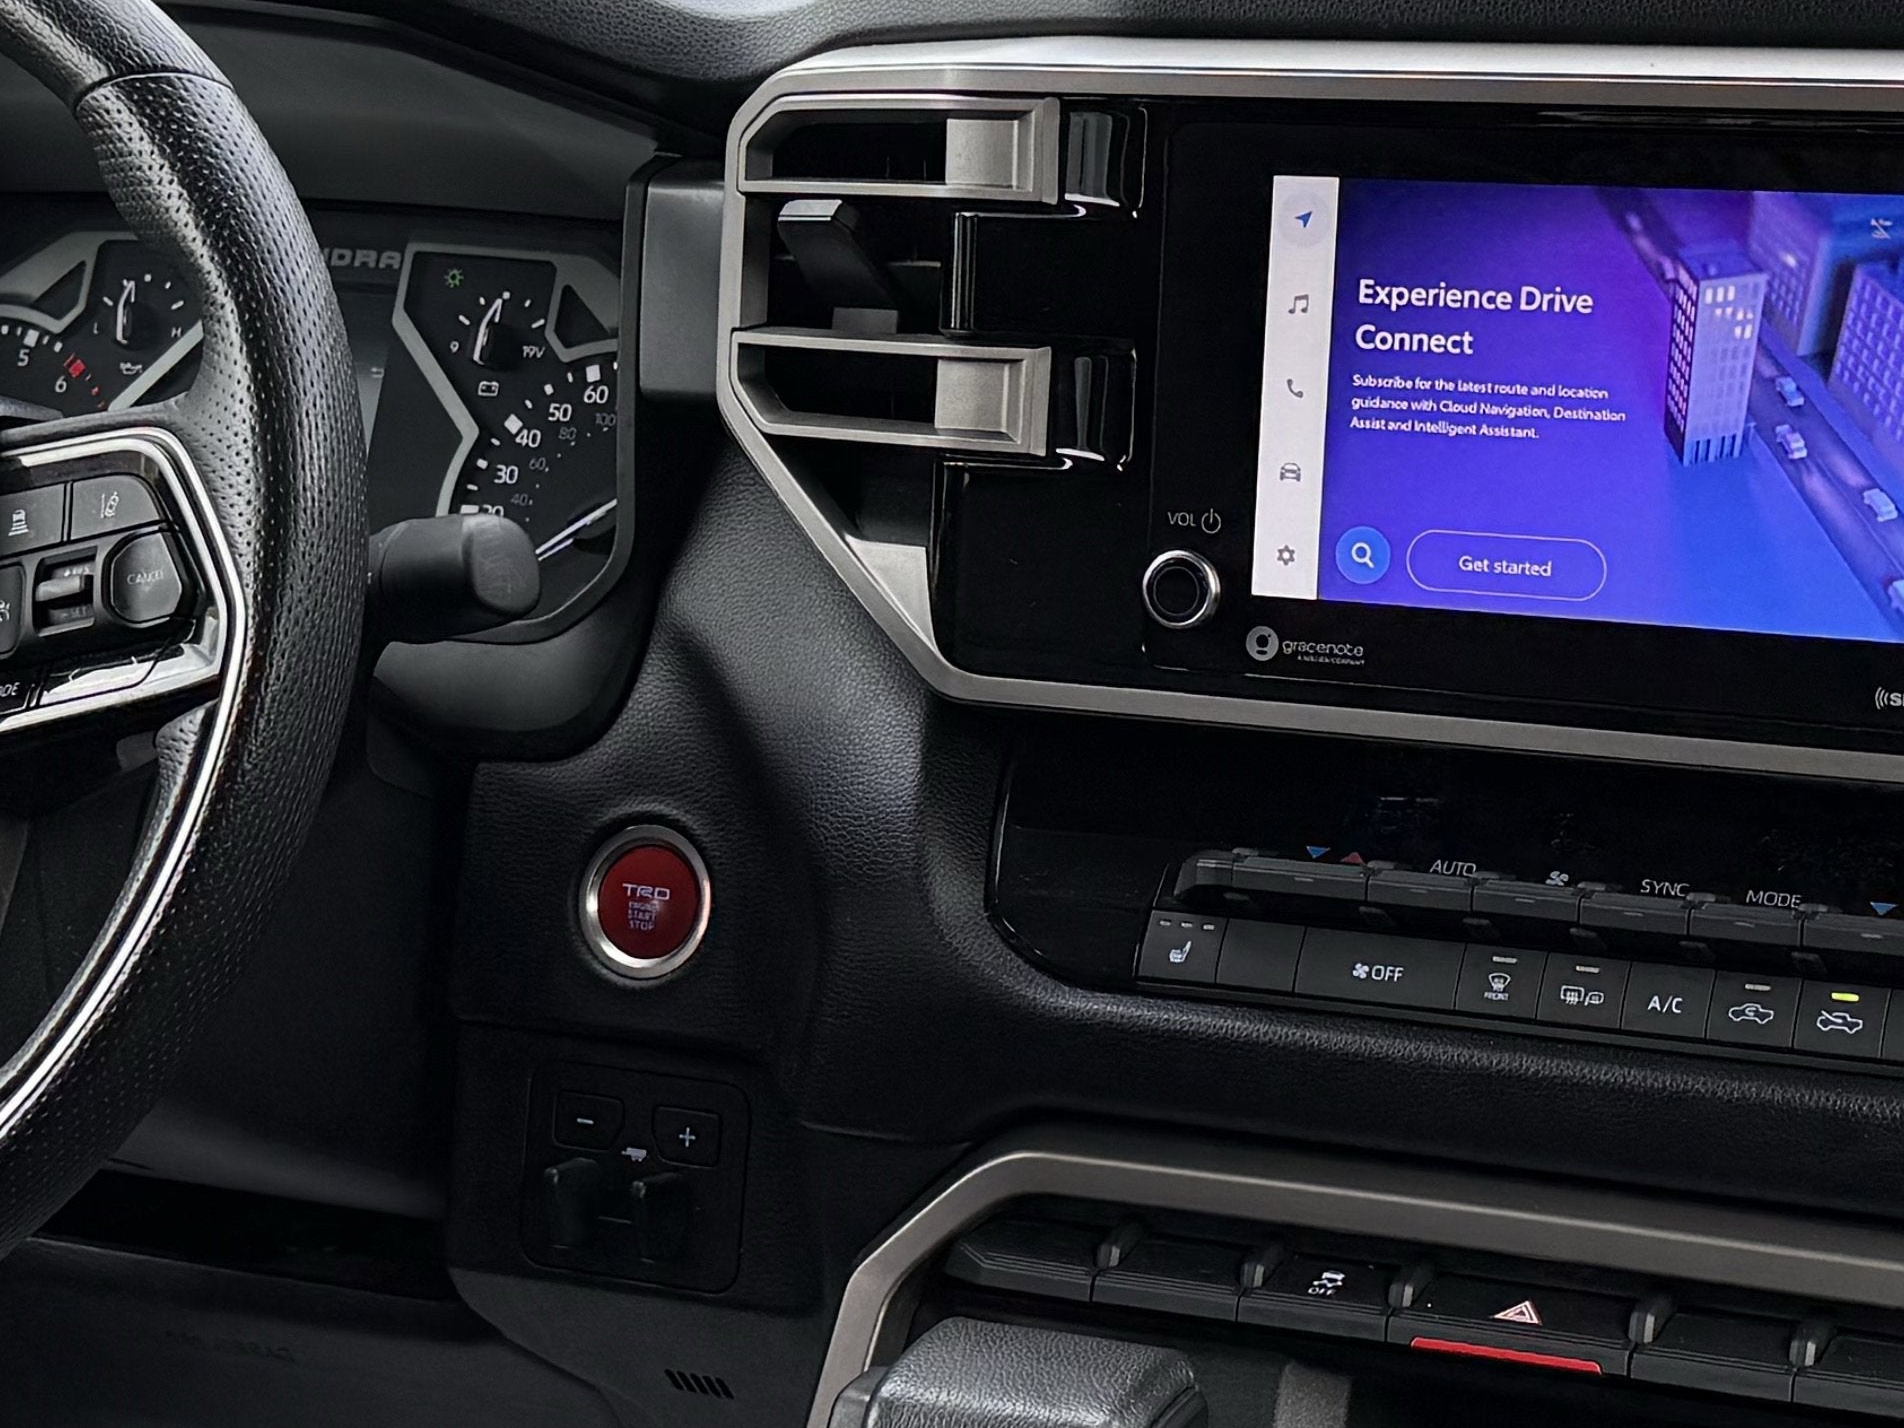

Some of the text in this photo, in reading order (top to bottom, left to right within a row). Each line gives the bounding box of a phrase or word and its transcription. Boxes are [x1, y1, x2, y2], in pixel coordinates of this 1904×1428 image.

[324, 247, 402, 270] DRA
[1358, 278, 1594, 314] Experience Drive
[171, 326, 183, 338] H
[1355, 324, 1474, 355] Connect
[450, 341, 460, 354] 9
[17, 348, 30, 368] 5
[54, 375, 67, 394] 6
[1352, 374, 1609, 400] Subscribe for the latest route and location
[583, 385, 609, 404] 60
[548, 403, 573, 422] 50
[1351, 397, 1626, 422] guidance with Cloud Navigation, Destination
[558, 426, 577, 440] 80
[1350, 416, 1539, 440] Assist and Intelligent Assistant.
[515, 429, 541, 448] 40
[528, 457, 546, 470] 60
[494, 464, 518, 485] 30
[510, 493, 529, 506] 40
[1167, 511, 1196, 528] VOL
[1458, 555, 1552, 577] Get started
[1282, 640, 1364, 657] gracenote
[1429, 858, 1477, 877] AUTO
[622, 883, 670, 901] TRD
[1640, 878, 1691, 898] SYNC
[1746, 889, 1802, 910] MODE
[1371, 965, 1405, 984] OFF
[1647, 994, 1684, 1014] A/C
